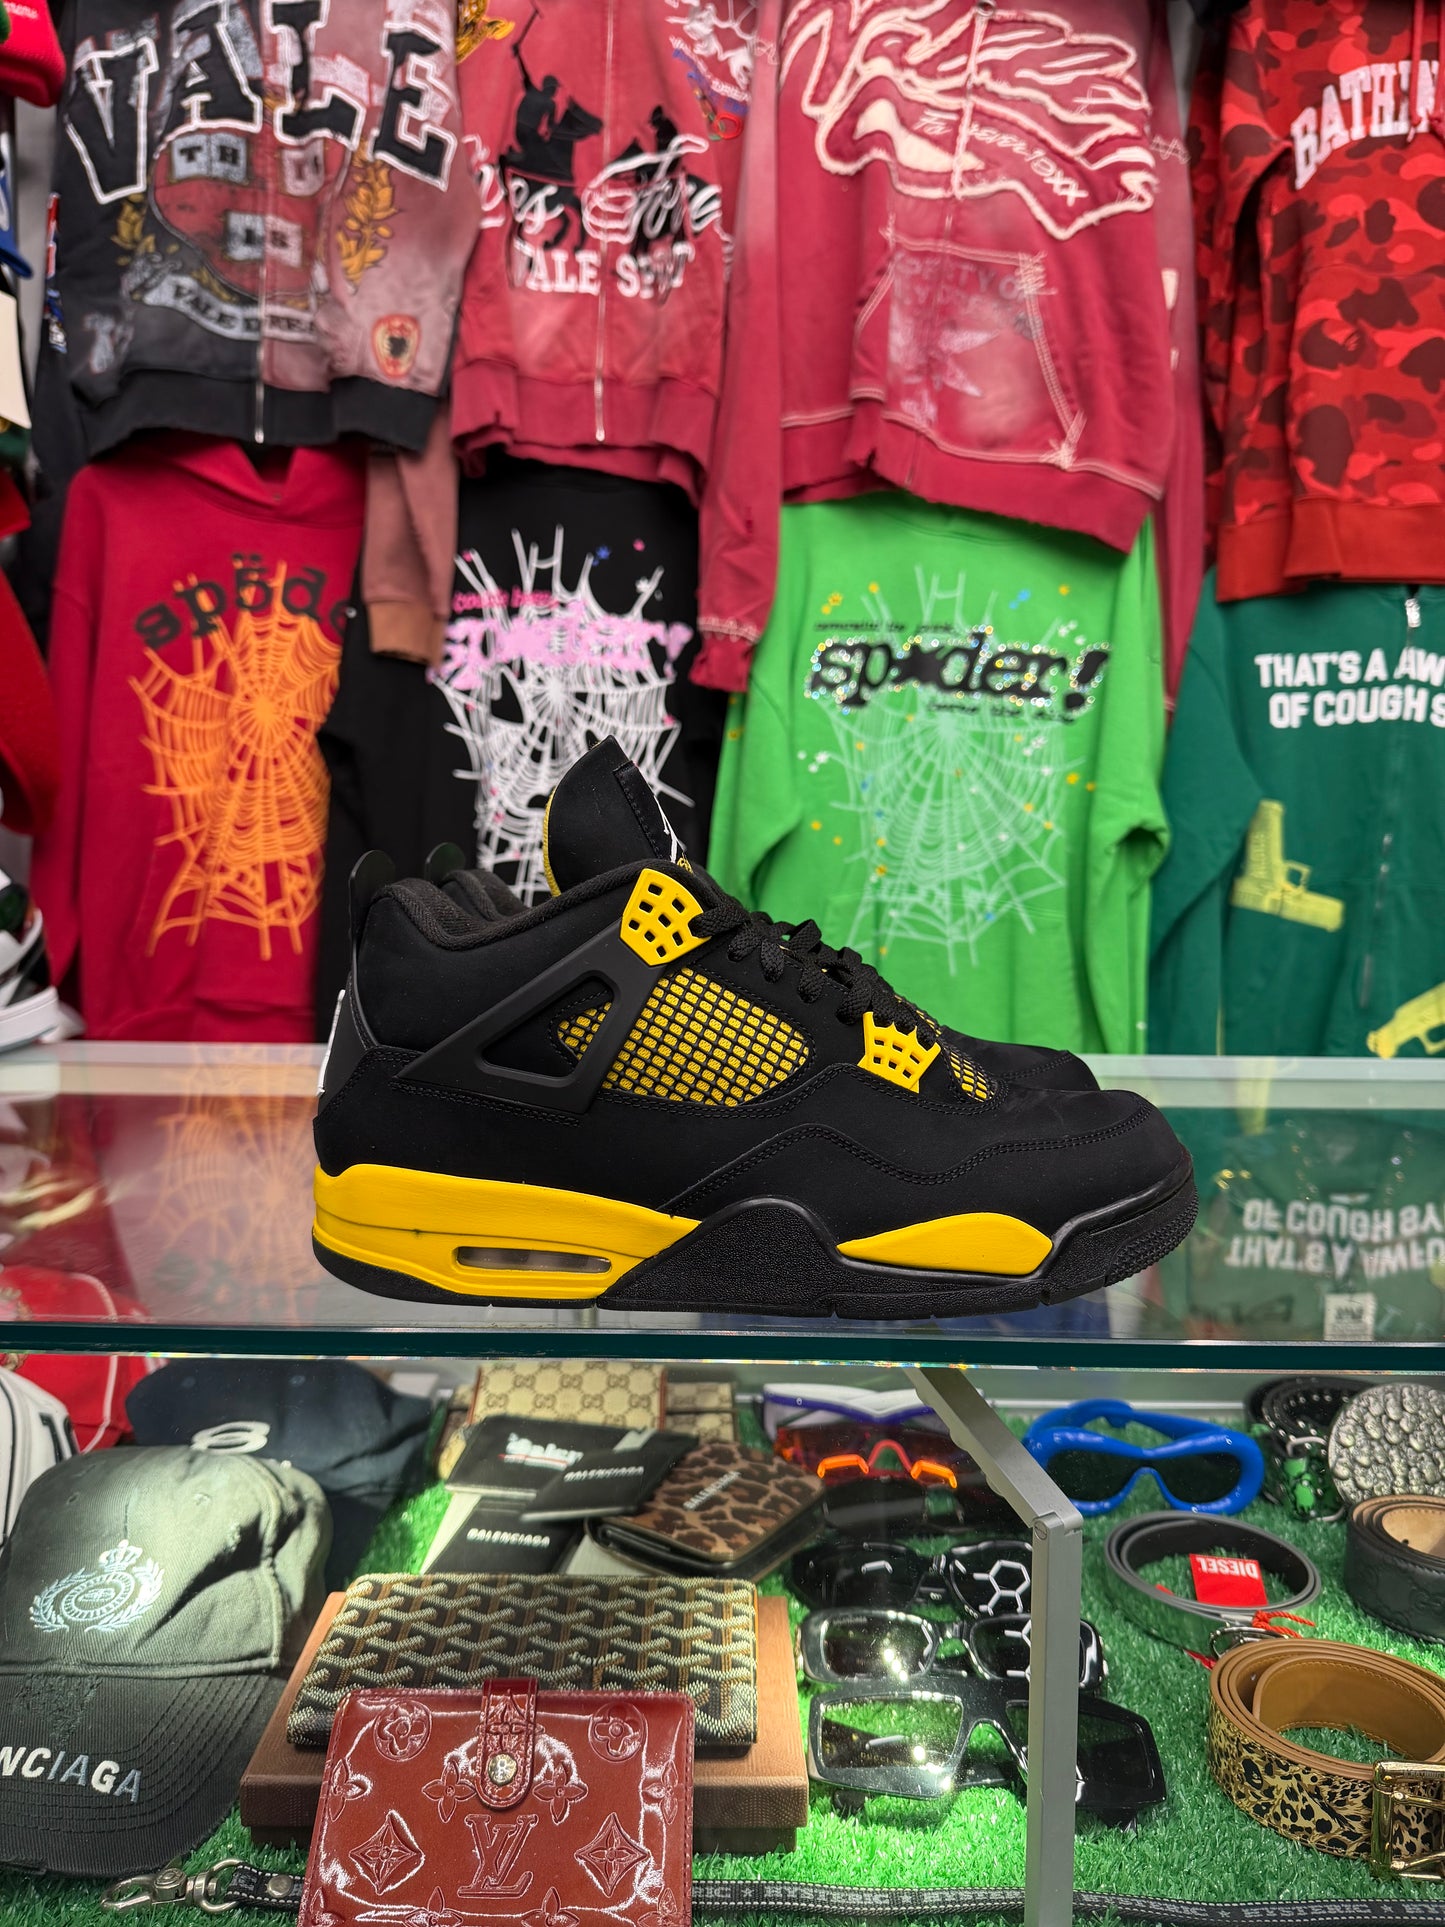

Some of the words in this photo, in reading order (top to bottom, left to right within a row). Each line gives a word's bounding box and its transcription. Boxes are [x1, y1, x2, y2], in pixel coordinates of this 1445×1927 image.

[64, 0, 457, 204] VALE
[1254, 650, 1362, 688] THAT'S
[1364, 648, 1388, 682] A
[1269, 691, 1311, 729] OF
[1313, 684, 1429, 727] COUGH
[1195, 1557, 1260, 1580] DIESEL
[457, 1814, 539, 1899] LV
